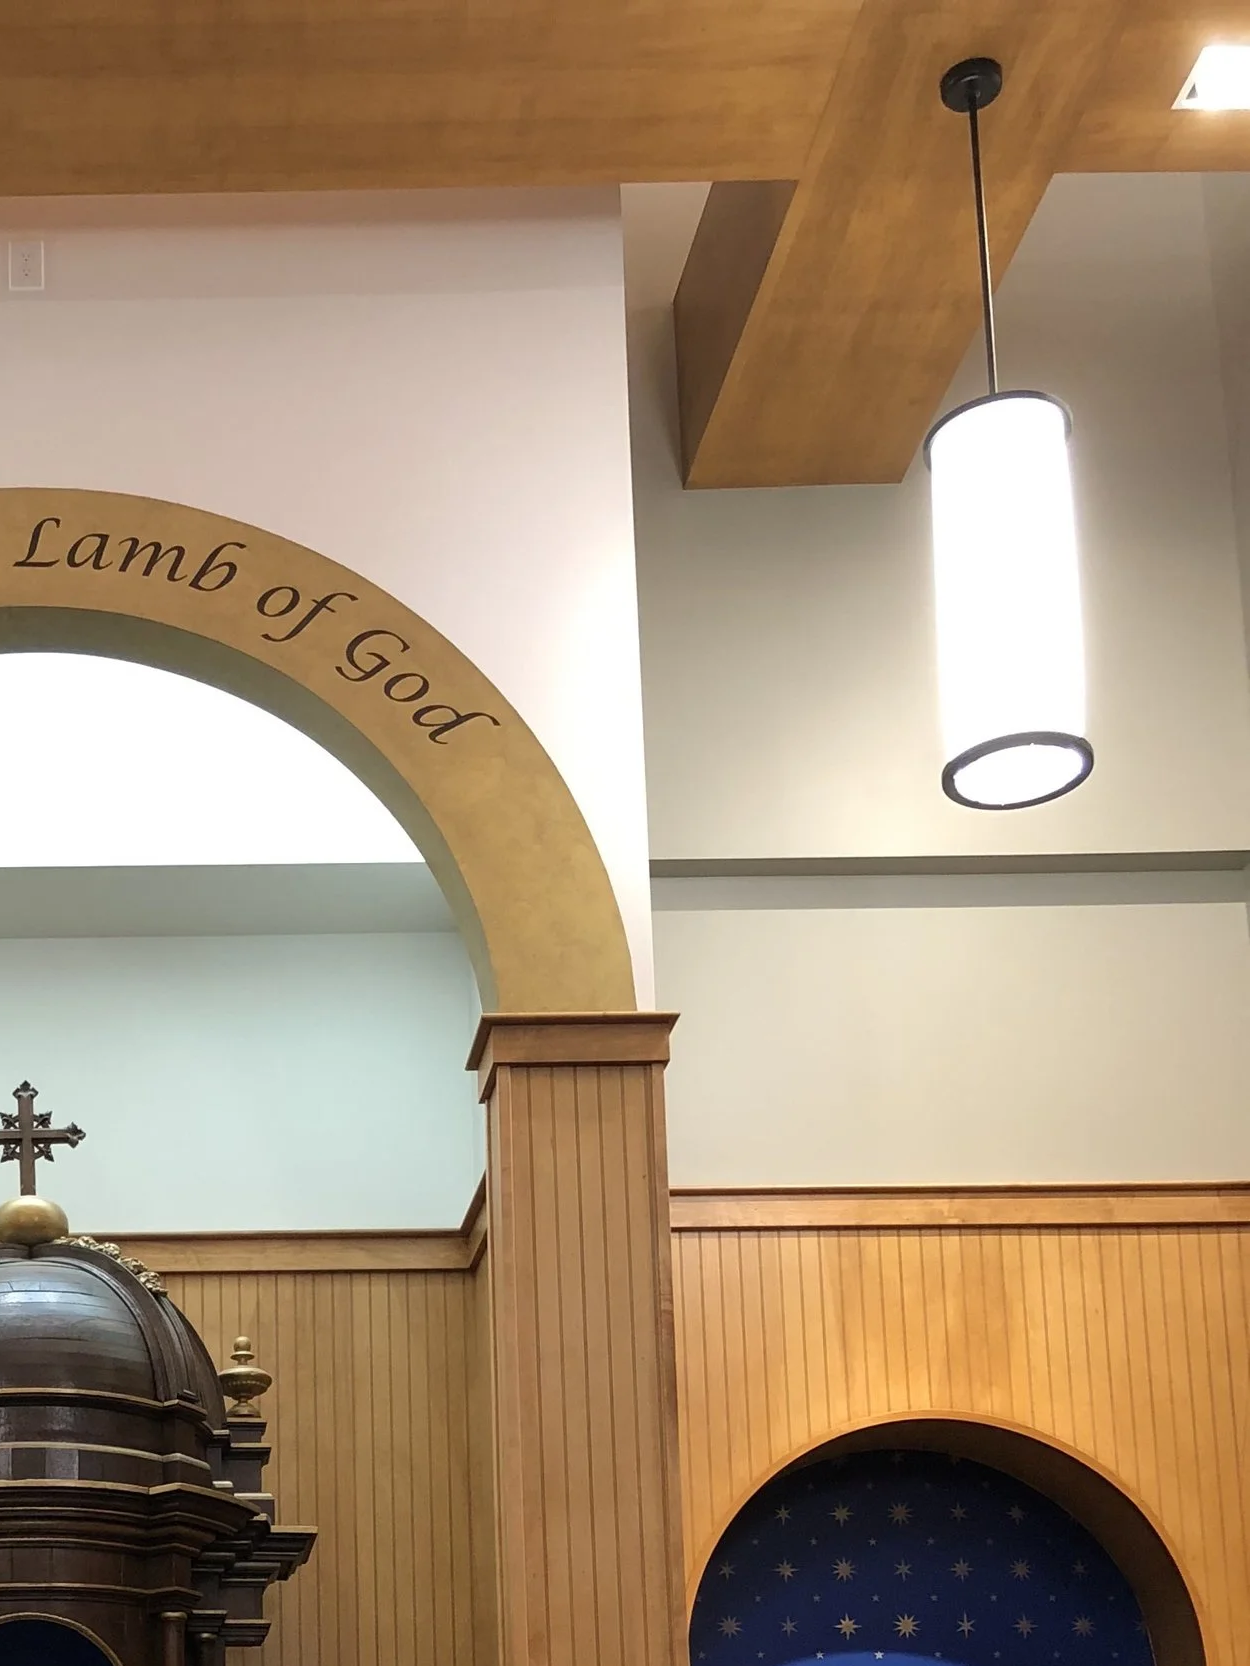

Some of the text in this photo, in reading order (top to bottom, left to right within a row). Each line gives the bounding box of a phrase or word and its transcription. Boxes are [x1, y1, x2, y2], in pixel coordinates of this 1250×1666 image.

[12, 516, 247, 592] Lamb
[256, 585, 360, 643] of
[334, 628, 501, 746] God
